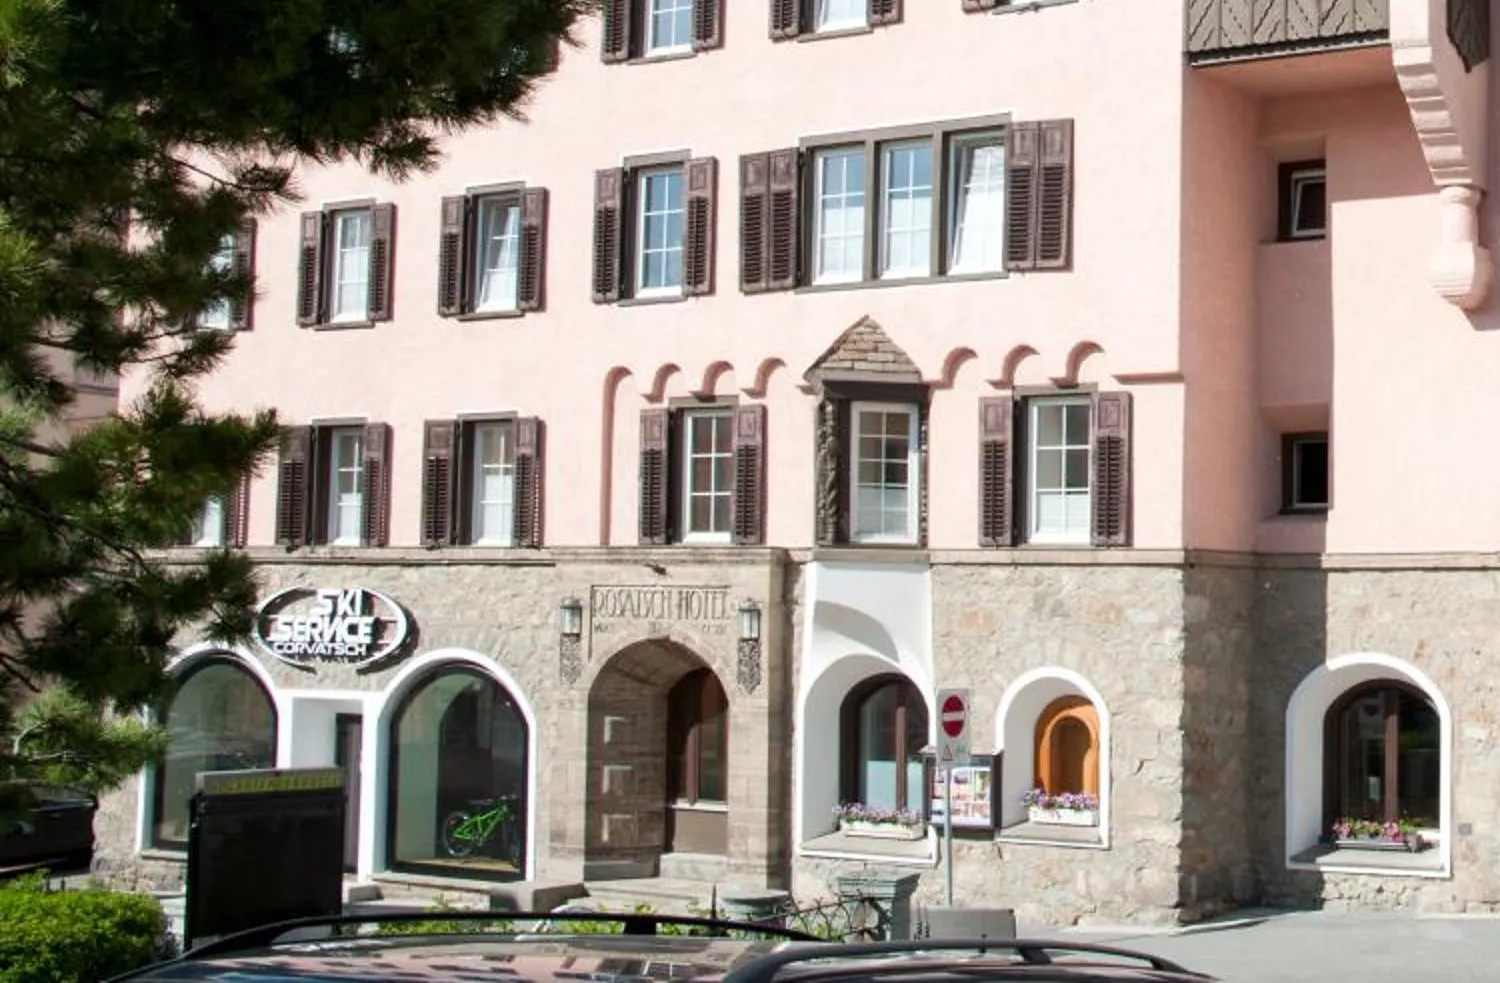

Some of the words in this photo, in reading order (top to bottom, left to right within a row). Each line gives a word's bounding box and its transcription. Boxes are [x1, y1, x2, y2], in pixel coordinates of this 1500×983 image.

[311, 588, 363, 617] SKI
[677, 590, 731, 620] HOTEL
[268, 616, 375, 644] SERVICE
[273, 642, 367, 656] CORVATSCH
